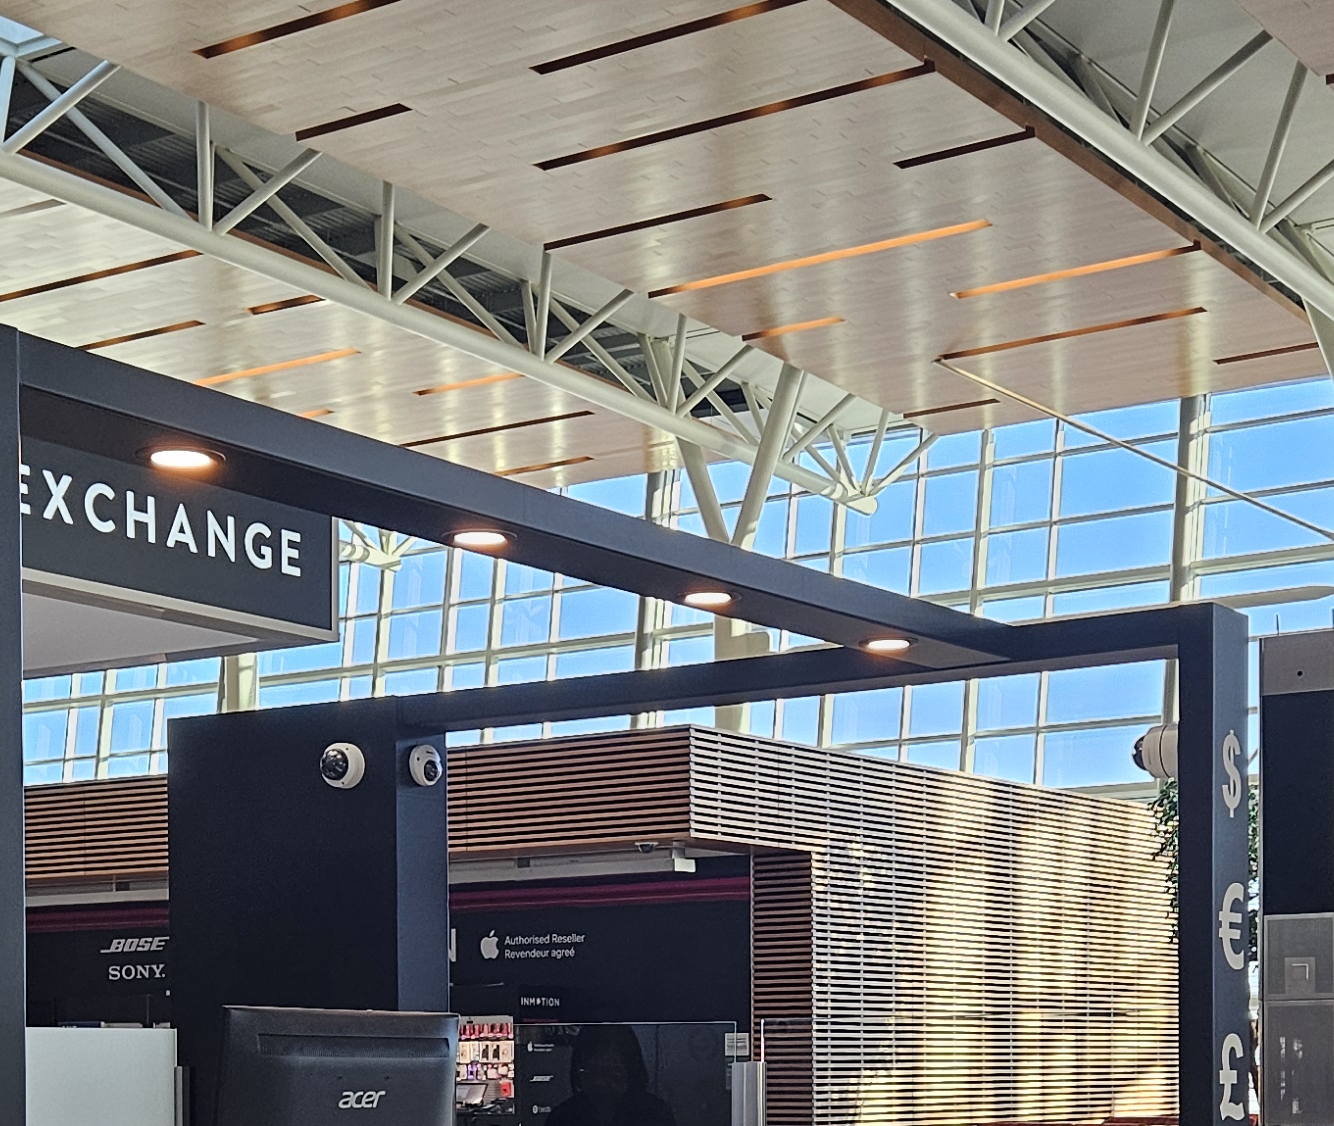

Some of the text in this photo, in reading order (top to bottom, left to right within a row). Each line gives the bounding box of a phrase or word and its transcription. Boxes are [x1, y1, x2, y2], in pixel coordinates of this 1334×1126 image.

[1221, 730, 1241, 818] $
[1219, 882, 1245, 969] €
[100, 936, 170, 953] BOSE
[504, 933, 585, 946] Authorised Reseller
[504, 948, 549, 959] Revendeur
[1220, 1033, 1245, 1121] £
[338, 1090, 386, 1108] acer
